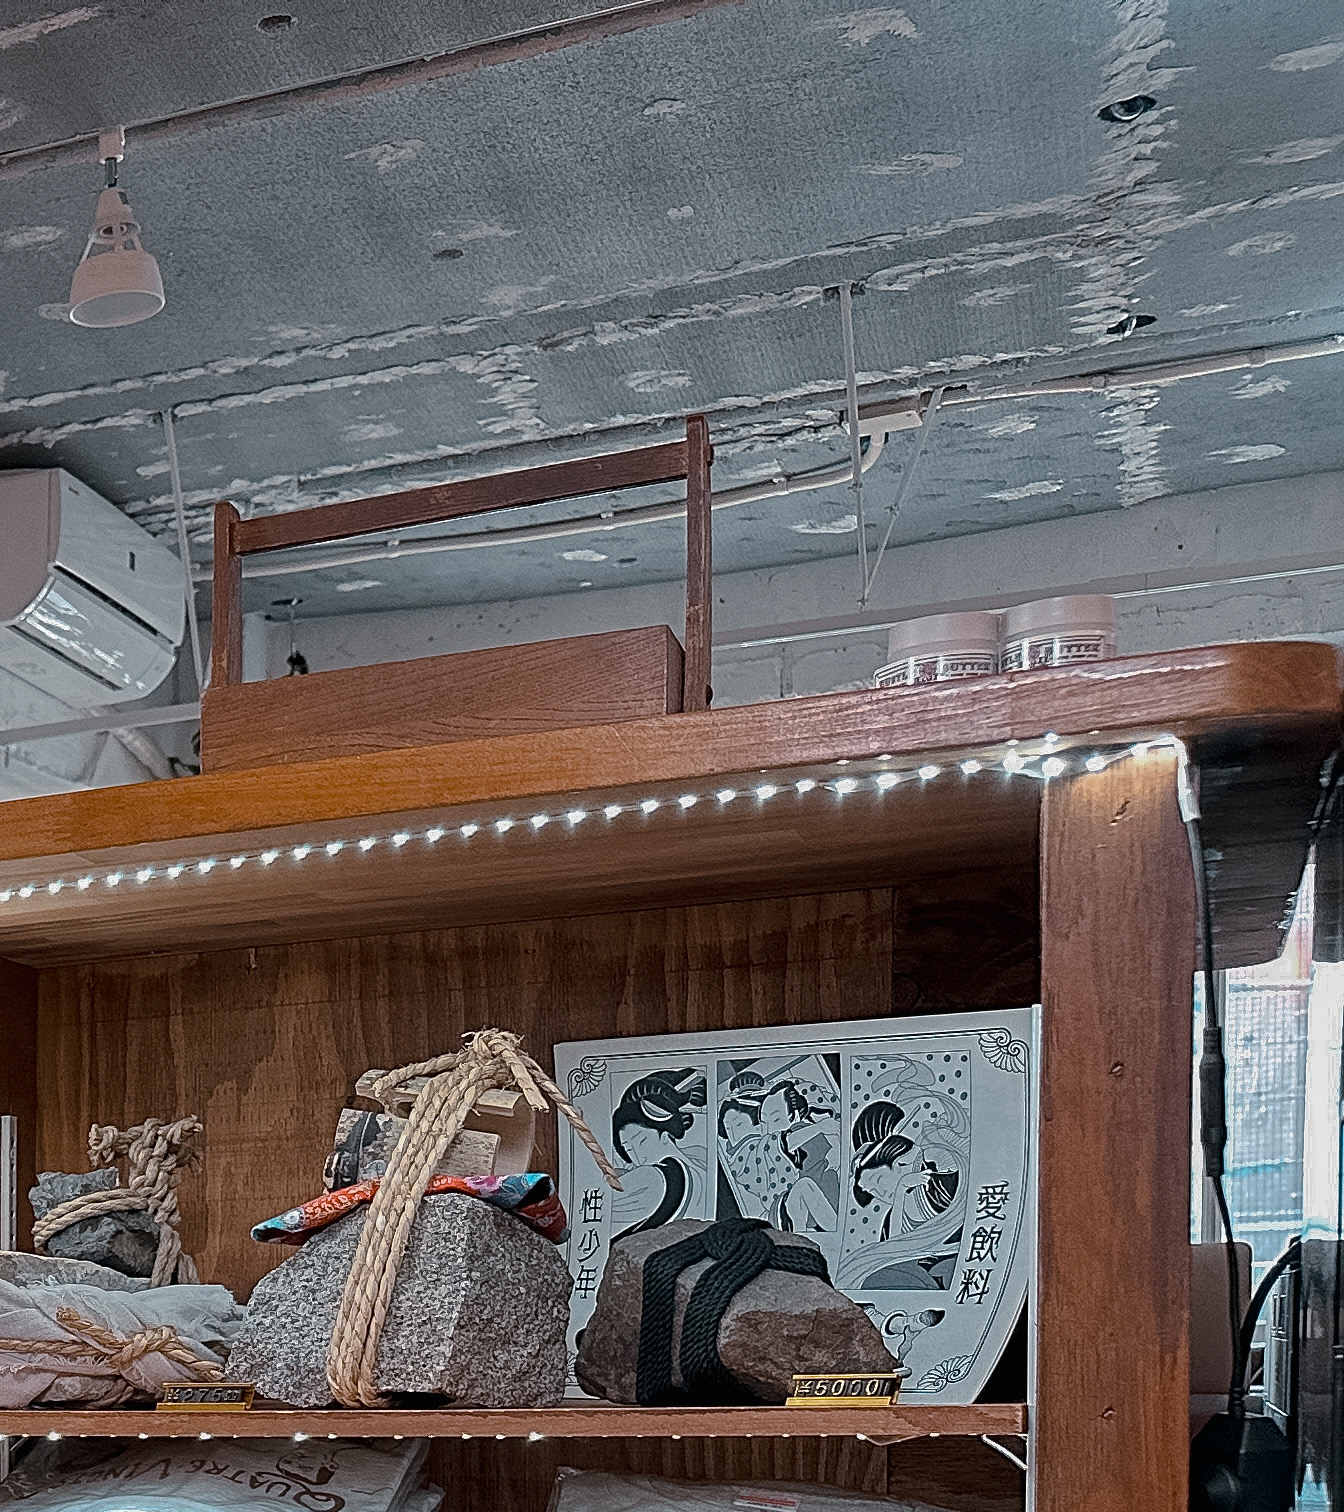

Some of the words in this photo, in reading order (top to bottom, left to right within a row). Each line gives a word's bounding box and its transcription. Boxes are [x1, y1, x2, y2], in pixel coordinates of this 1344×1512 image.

[574, 1187, 604, 1301] 性少年
[955, 1180, 1010, 1306] 愛飲料
